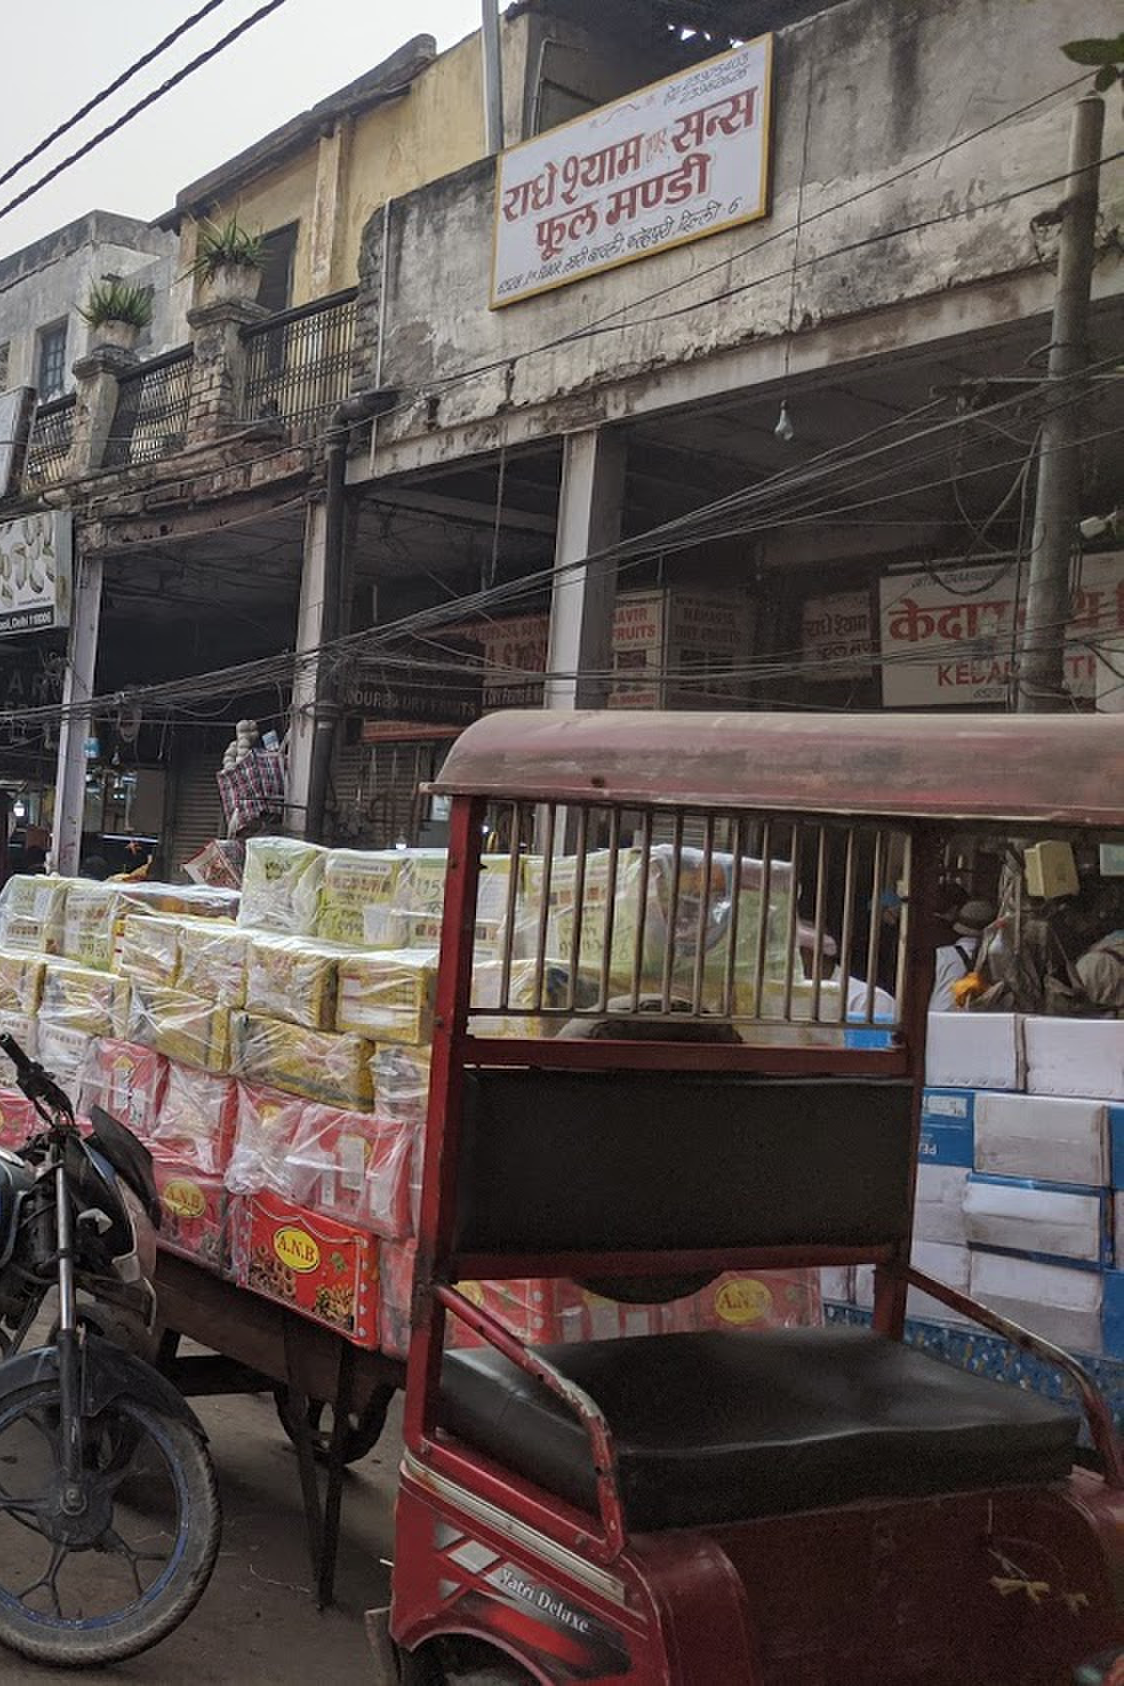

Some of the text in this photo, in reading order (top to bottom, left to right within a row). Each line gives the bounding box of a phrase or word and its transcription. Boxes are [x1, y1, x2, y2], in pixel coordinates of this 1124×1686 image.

[502, 161, 558, 222] राधे
[672, 86, 758, 152] सन्स
[537, 152, 711, 261] फूल मण्डी
[276, 1234, 315, 1263] A.N.B
[500, 1568, 590, 1633] Yatri Deluxe
